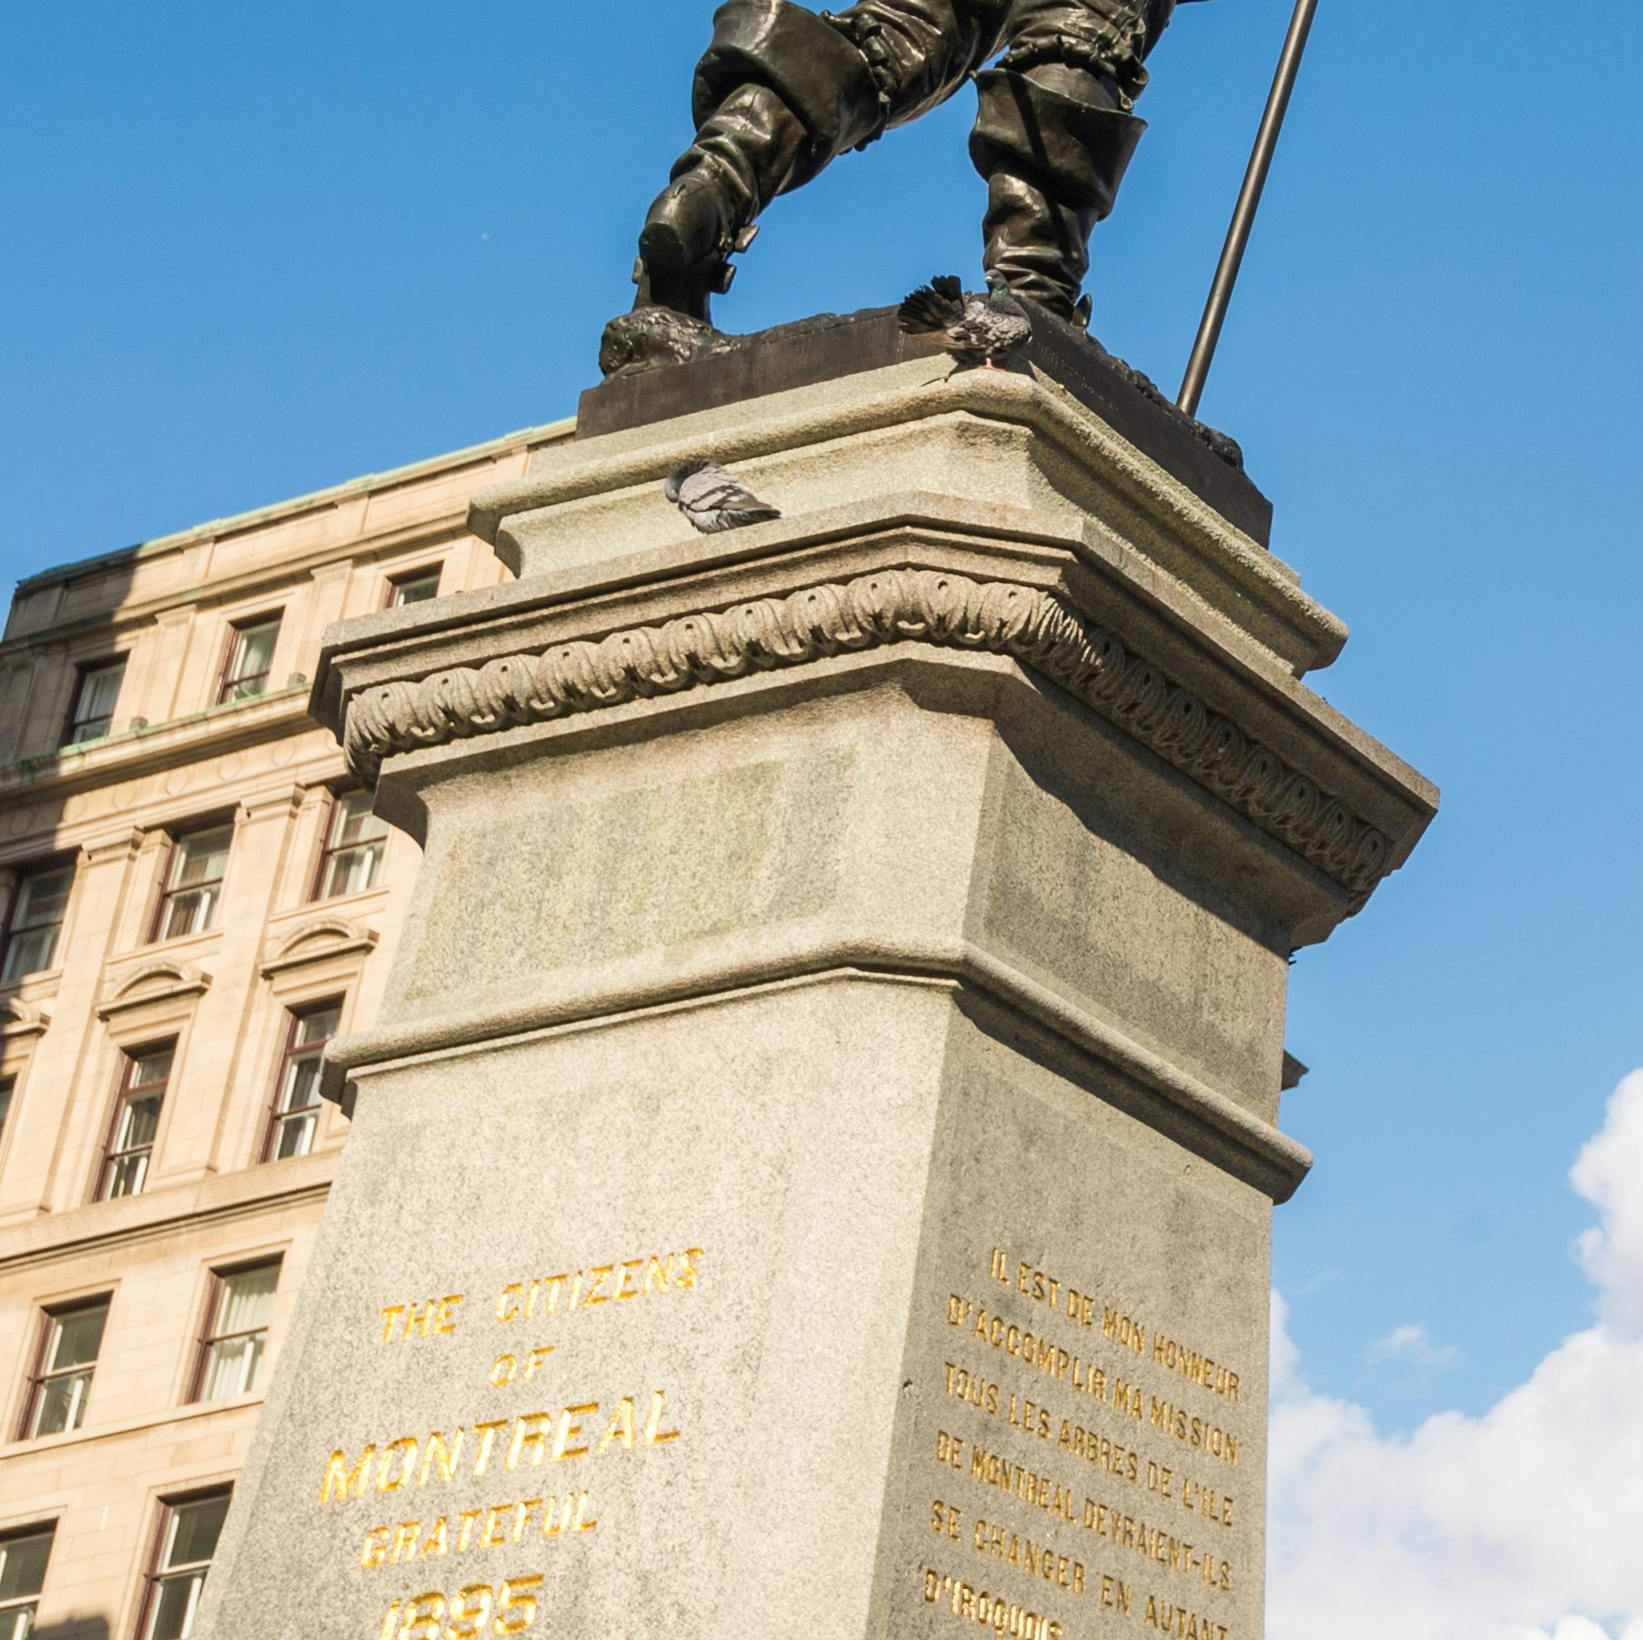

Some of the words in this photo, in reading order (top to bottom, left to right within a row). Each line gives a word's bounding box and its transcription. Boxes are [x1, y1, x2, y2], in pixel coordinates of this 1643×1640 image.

[381, 1293, 464, 1346] THE
[495, 1247, 704, 1323] CITIZENS
[991, 1246, 1010, 1286] IL
[1018, 1261, 1061, 1310] EST
[1066, 1288, 1095, 1329] DE
[1103, 1306, 1145, 1355] MON
[1152, 1331, 1240, 1403] HONNEUR
[489, 1345, 555, 1386] OF
[1113, 1377, 1143, 1420] MA
[318, 1389, 681, 1506] MONTREAL
[936, 1430, 964, 1471] DE
[970, 1445, 1077, 1525] MONTREAL
[944, 1361, 1000, 1416] TOUS
[1008, 1393, 1052, 1440] LES
[1056, 1419, 1139, 1484] ARBRES
[1148, 1461, 1173, 1499] DE
[360, 1491, 598, 1570] GRATEFUL
[930, 1500, 963, 1542] SE
[974, 1519, 1087, 1596] CHANGER
[1101, 1574, 1133, 1617] EN
[380, 1573, 545, 1640] 1895
